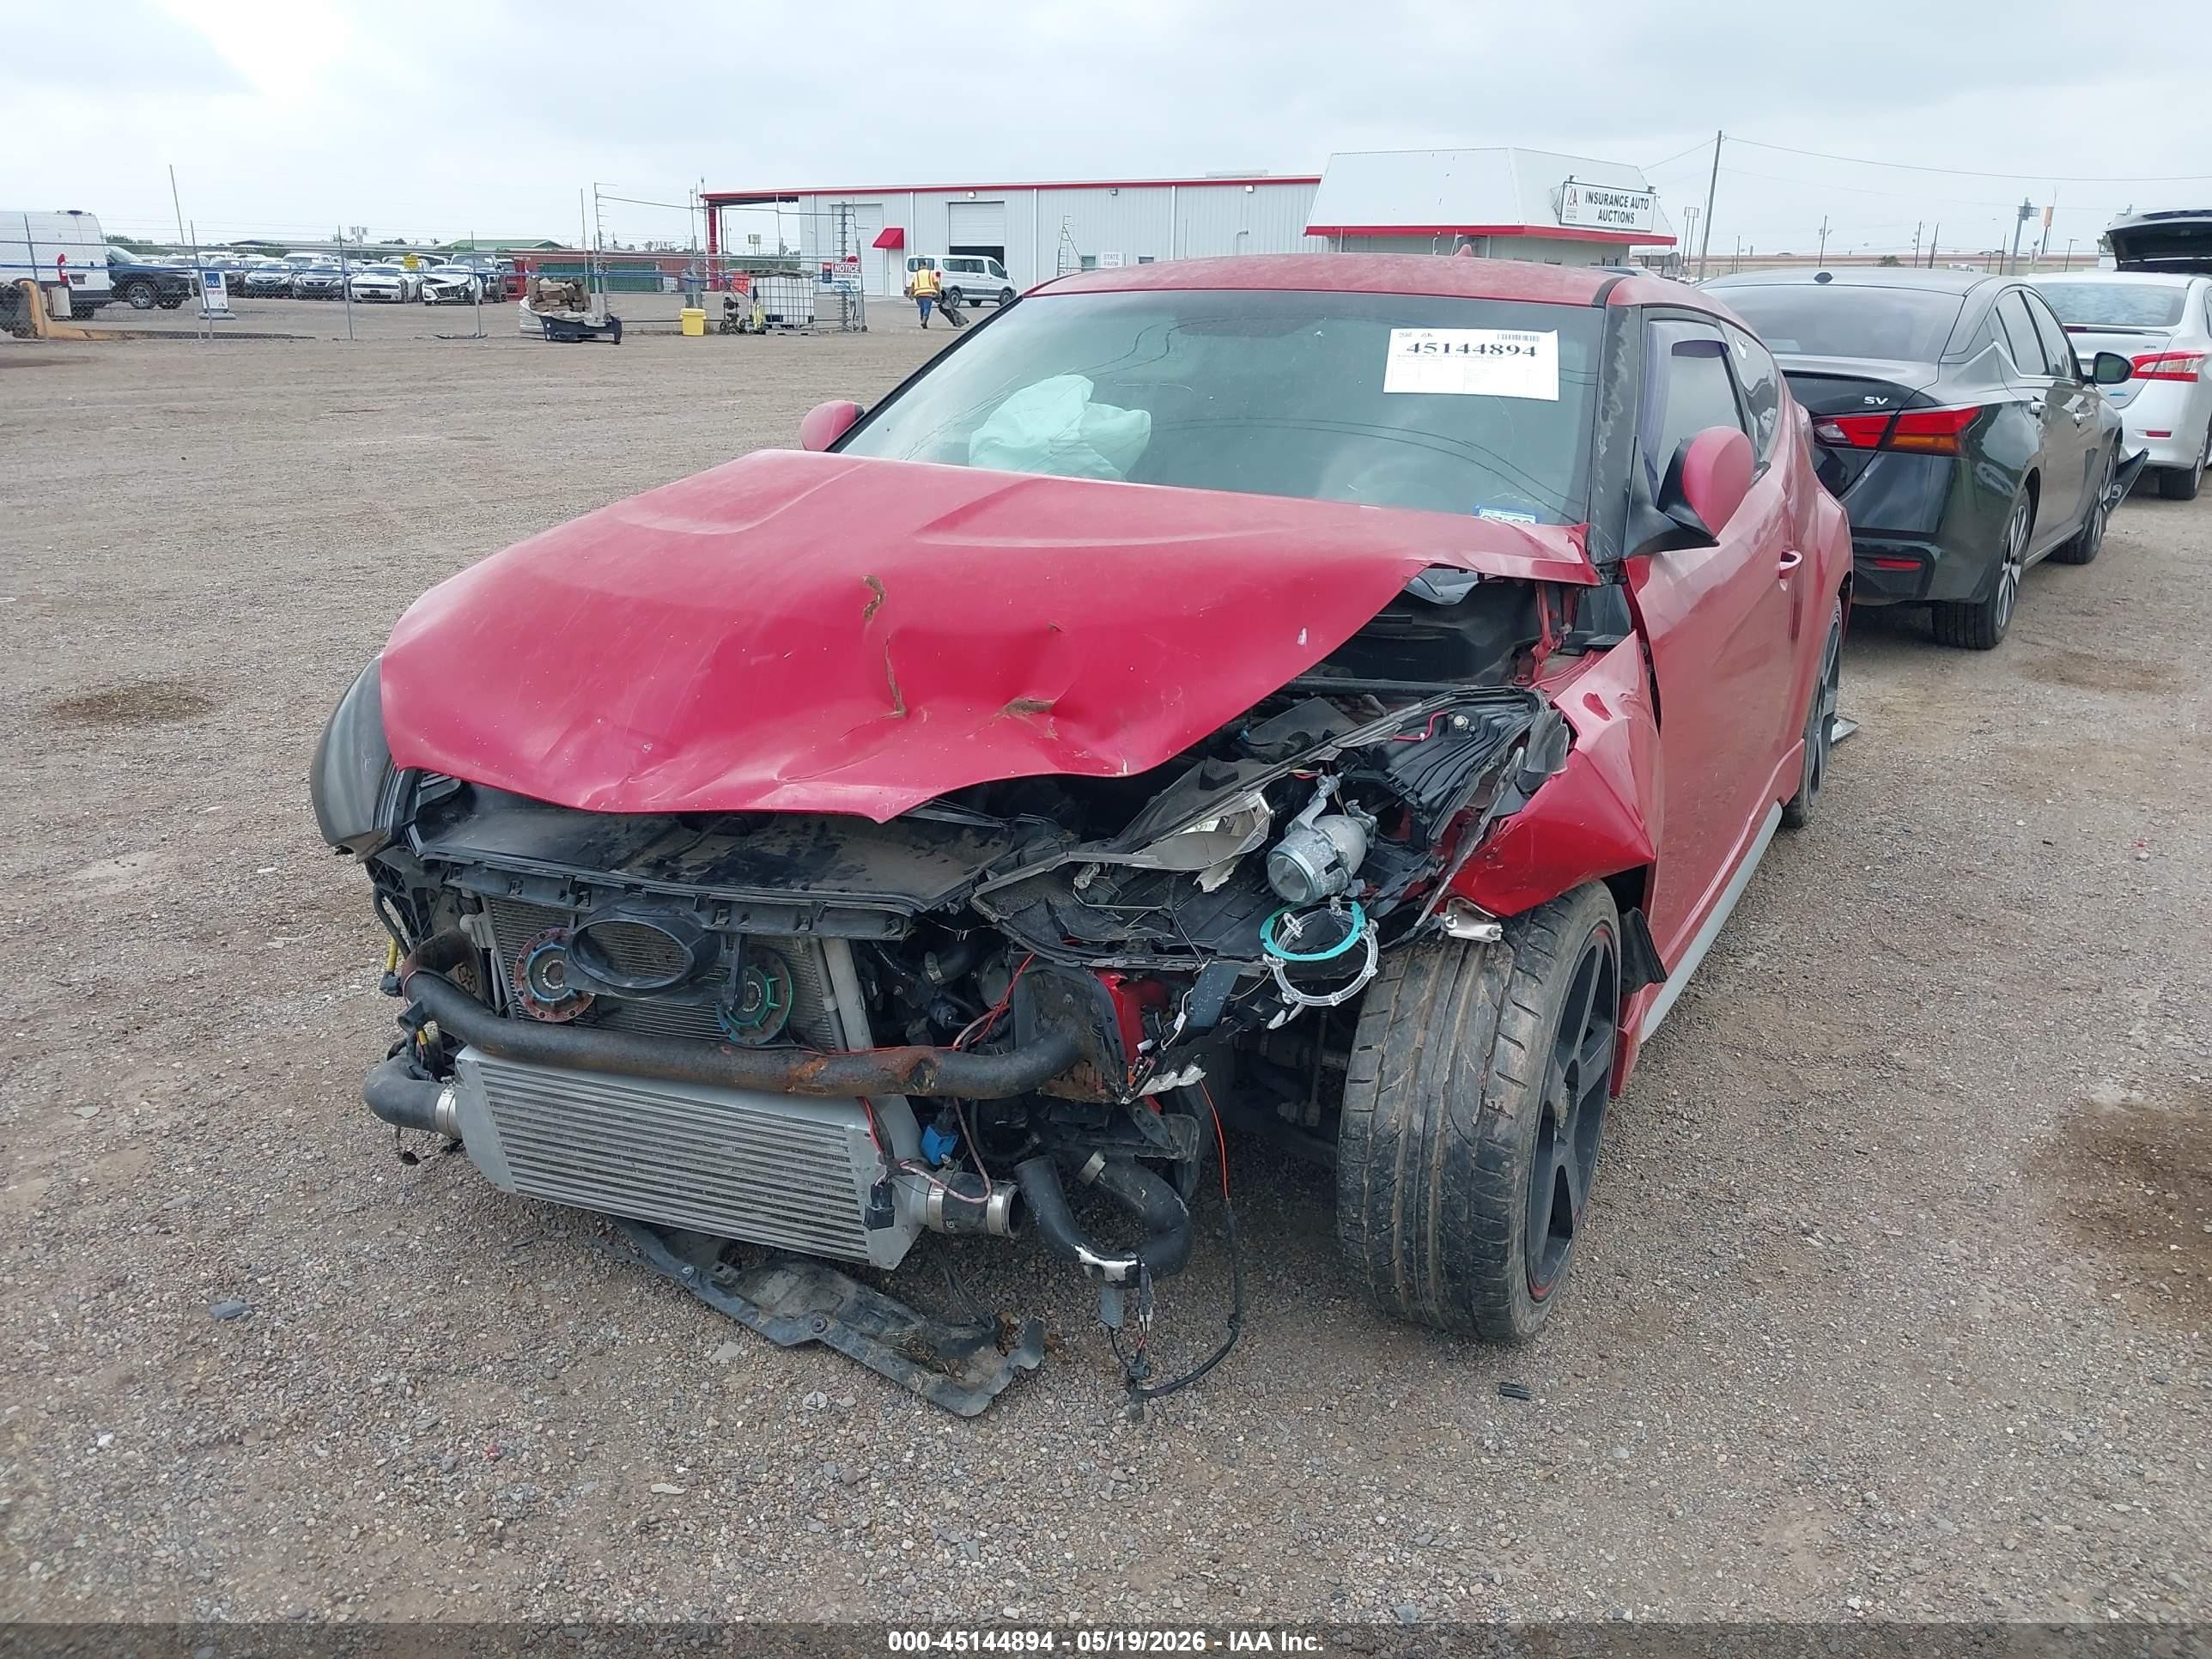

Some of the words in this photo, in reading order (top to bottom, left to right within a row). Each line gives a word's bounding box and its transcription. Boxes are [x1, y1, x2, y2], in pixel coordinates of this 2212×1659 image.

[1585, 191, 1629, 208] INSURANCE
[1630, 197, 1650, 210] AUTO
[1597, 209, 1635, 224] AUCTIONS
[834, 264, 860, 273] NOTICE
[1407, 342, 1537, 357] 45144894
[1863, 396, 1889, 405] SV
